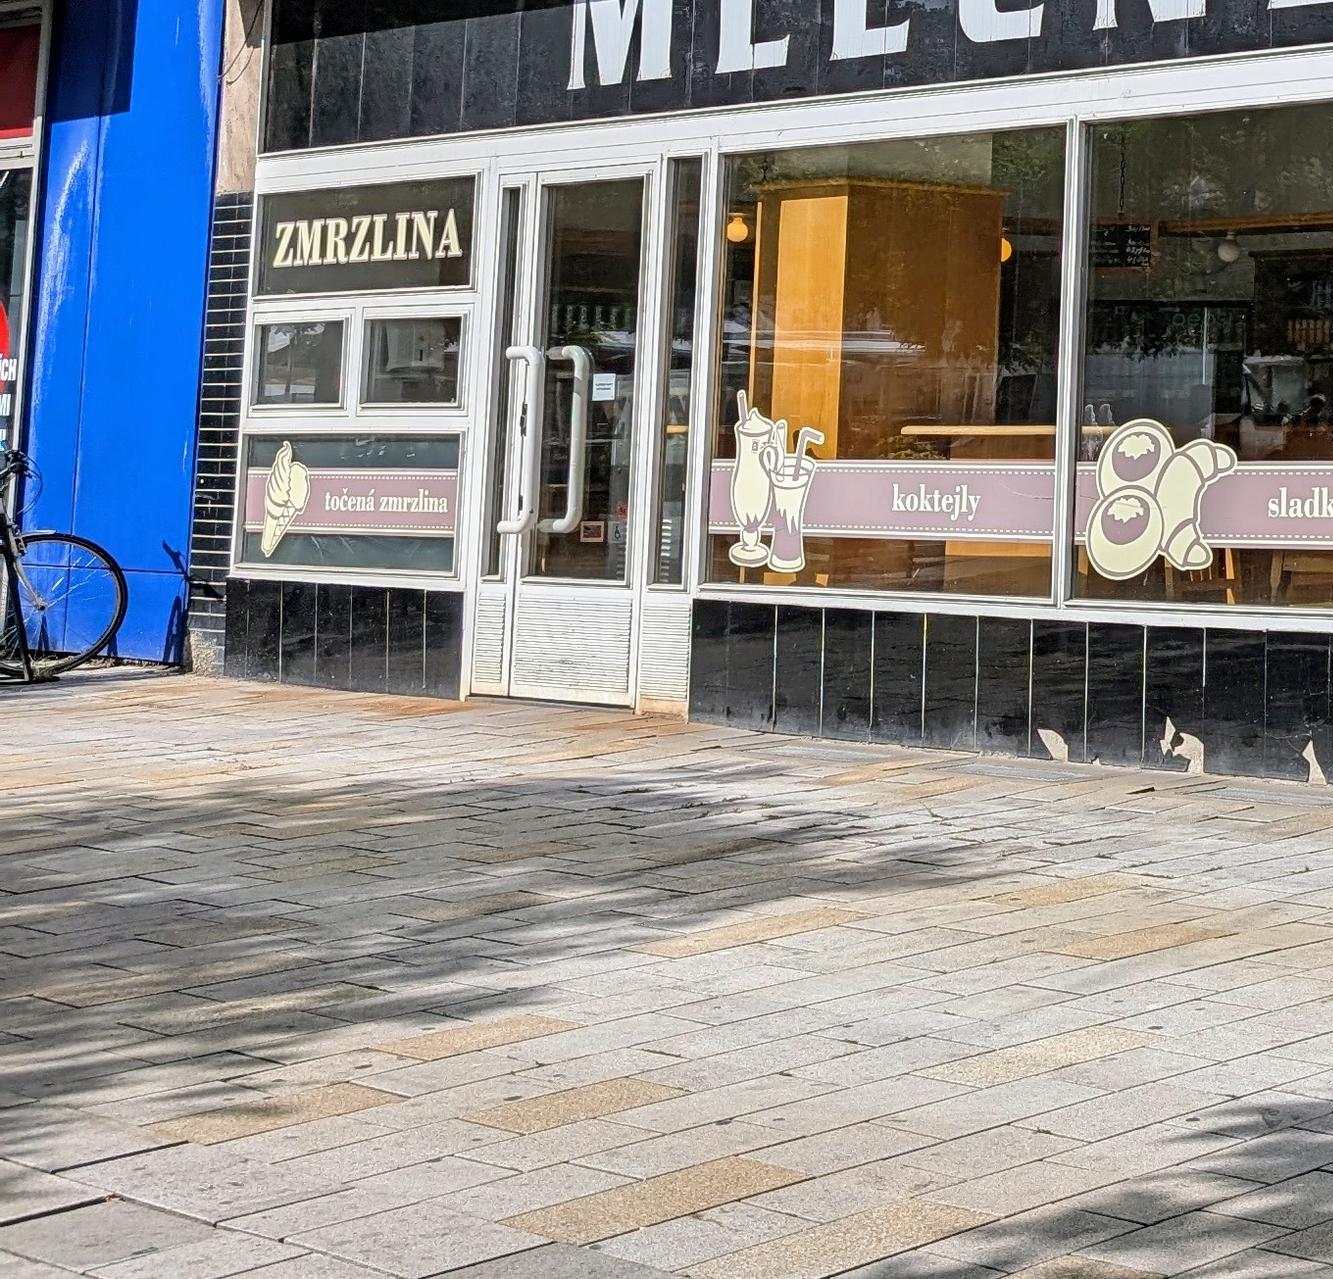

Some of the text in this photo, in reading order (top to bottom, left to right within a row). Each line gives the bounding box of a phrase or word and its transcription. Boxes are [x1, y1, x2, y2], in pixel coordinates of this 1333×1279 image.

[273, 209, 462, 268] ZMRZLINA
[325, 487, 448, 513] točená zmrzlina
[892, 483, 981, 521] koktejly
